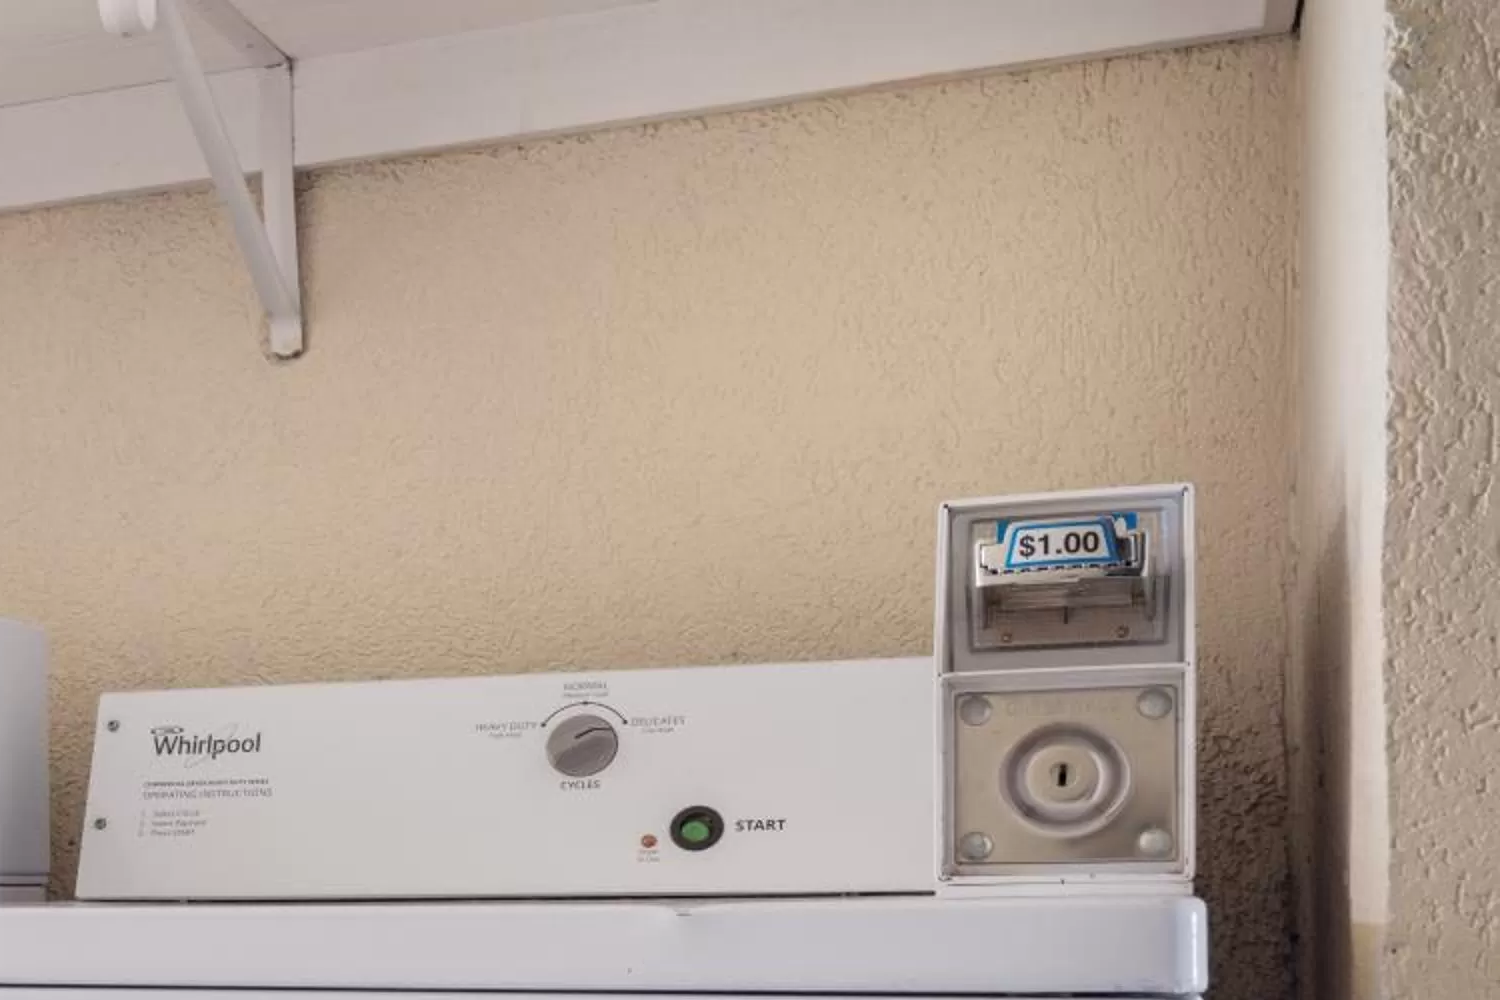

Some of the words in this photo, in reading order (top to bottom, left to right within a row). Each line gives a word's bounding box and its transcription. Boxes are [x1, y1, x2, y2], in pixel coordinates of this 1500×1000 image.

[1019, 530, 1100, 557] $1.00
[153, 732, 263, 760] Whirlpool
[559, 779, 601, 791] CYCLES
[734, 818, 787, 832] START
